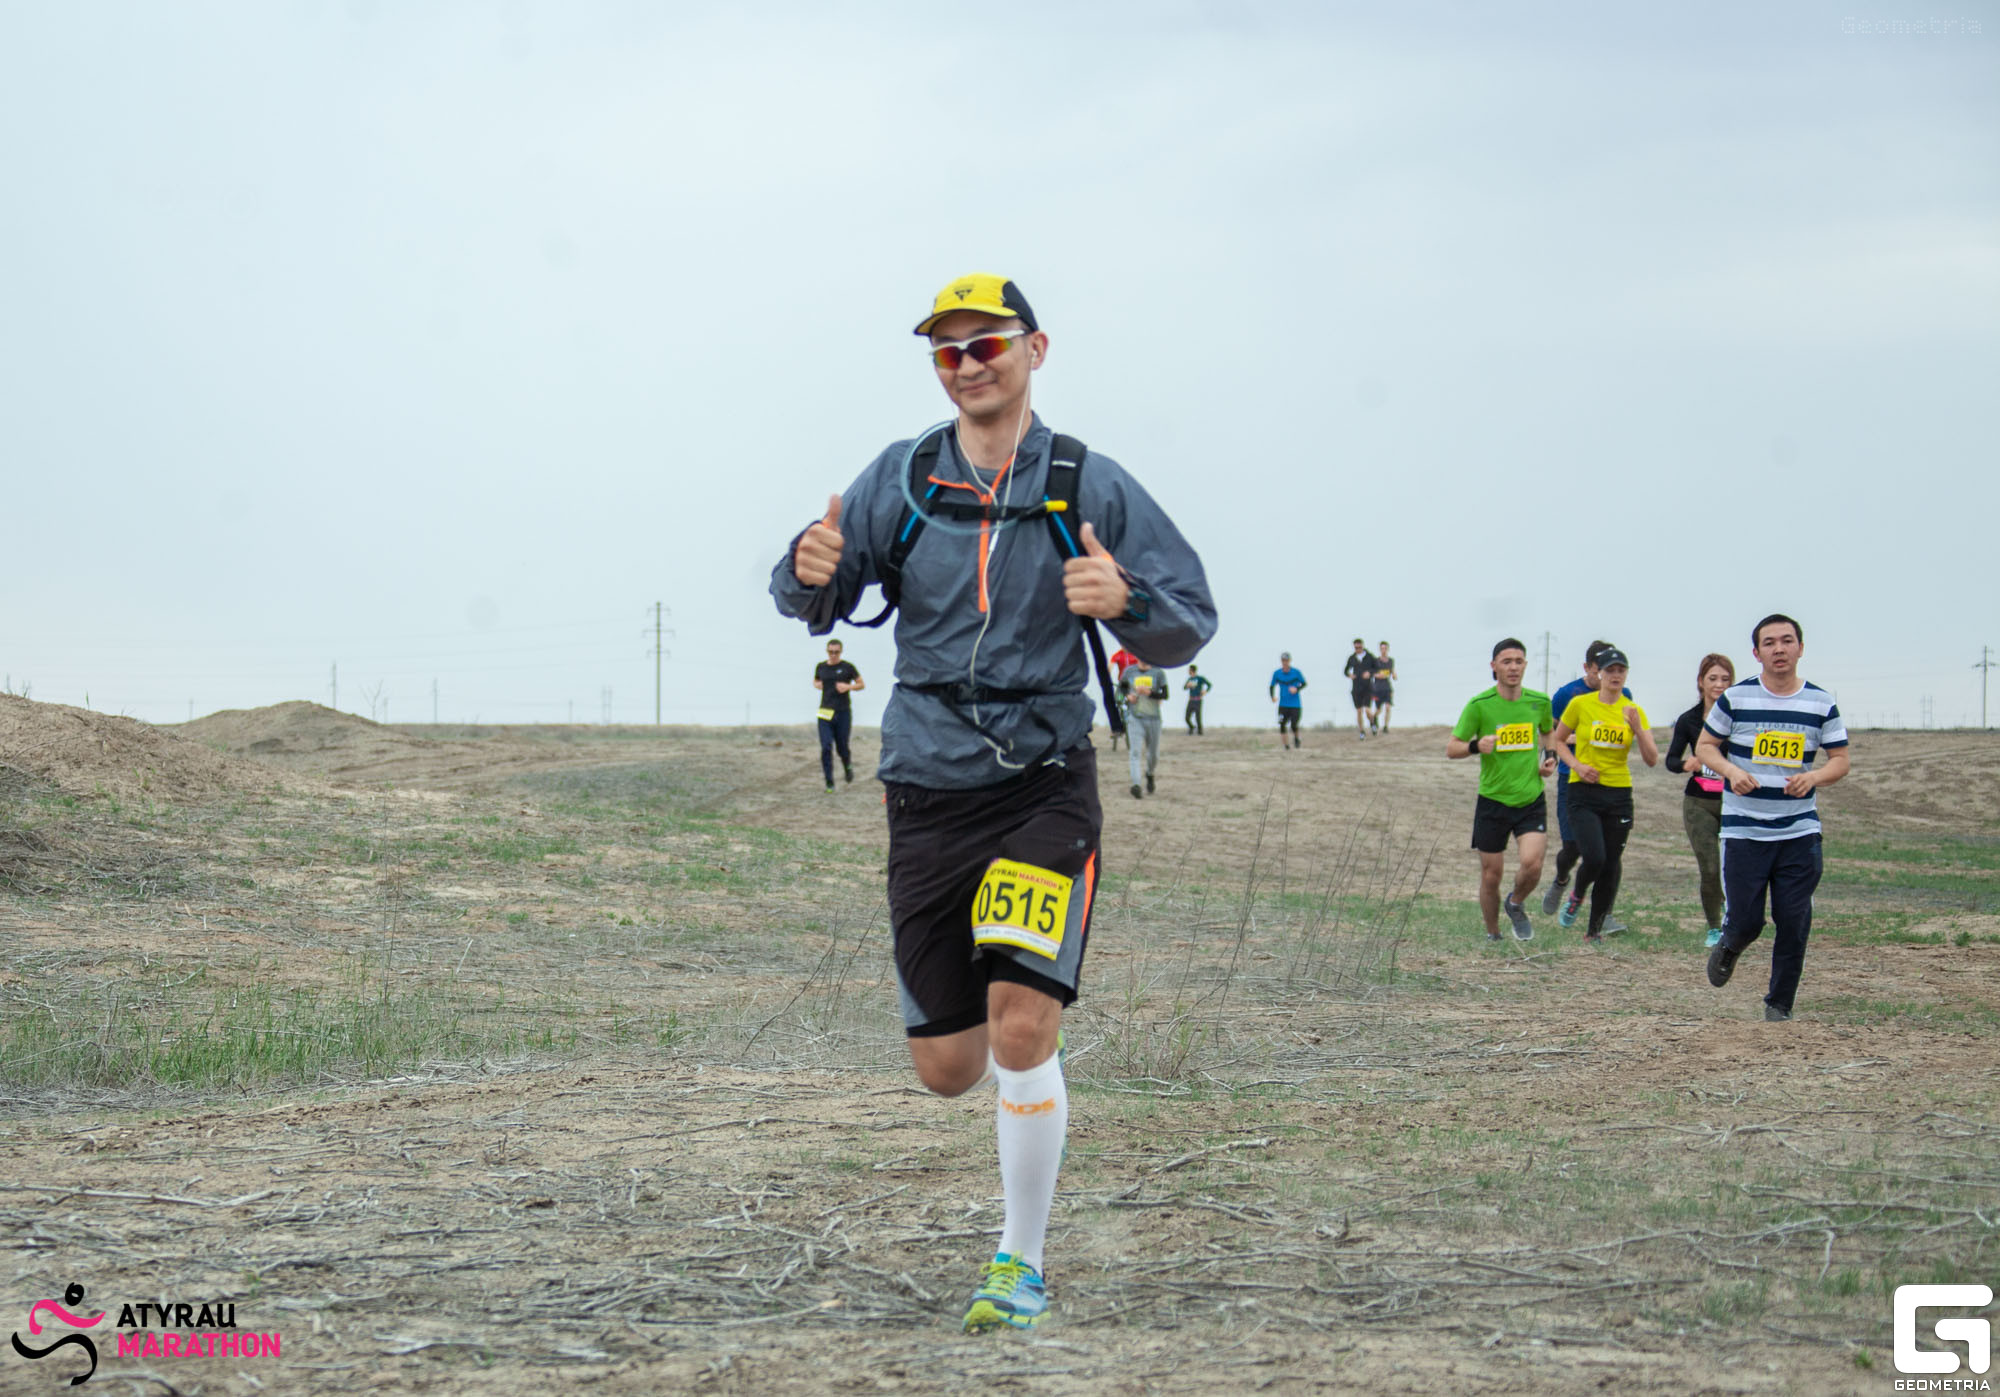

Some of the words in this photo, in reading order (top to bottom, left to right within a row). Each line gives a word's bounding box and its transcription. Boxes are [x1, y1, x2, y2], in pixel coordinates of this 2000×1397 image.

[1500, 730, 1530, 745] 0385
[1594, 728, 1624, 744] 0304
[1758, 738, 1799, 759] 0513
[1019, 872, 1058, 889] MARATHON
[978, 882, 1058, 934] 0515
